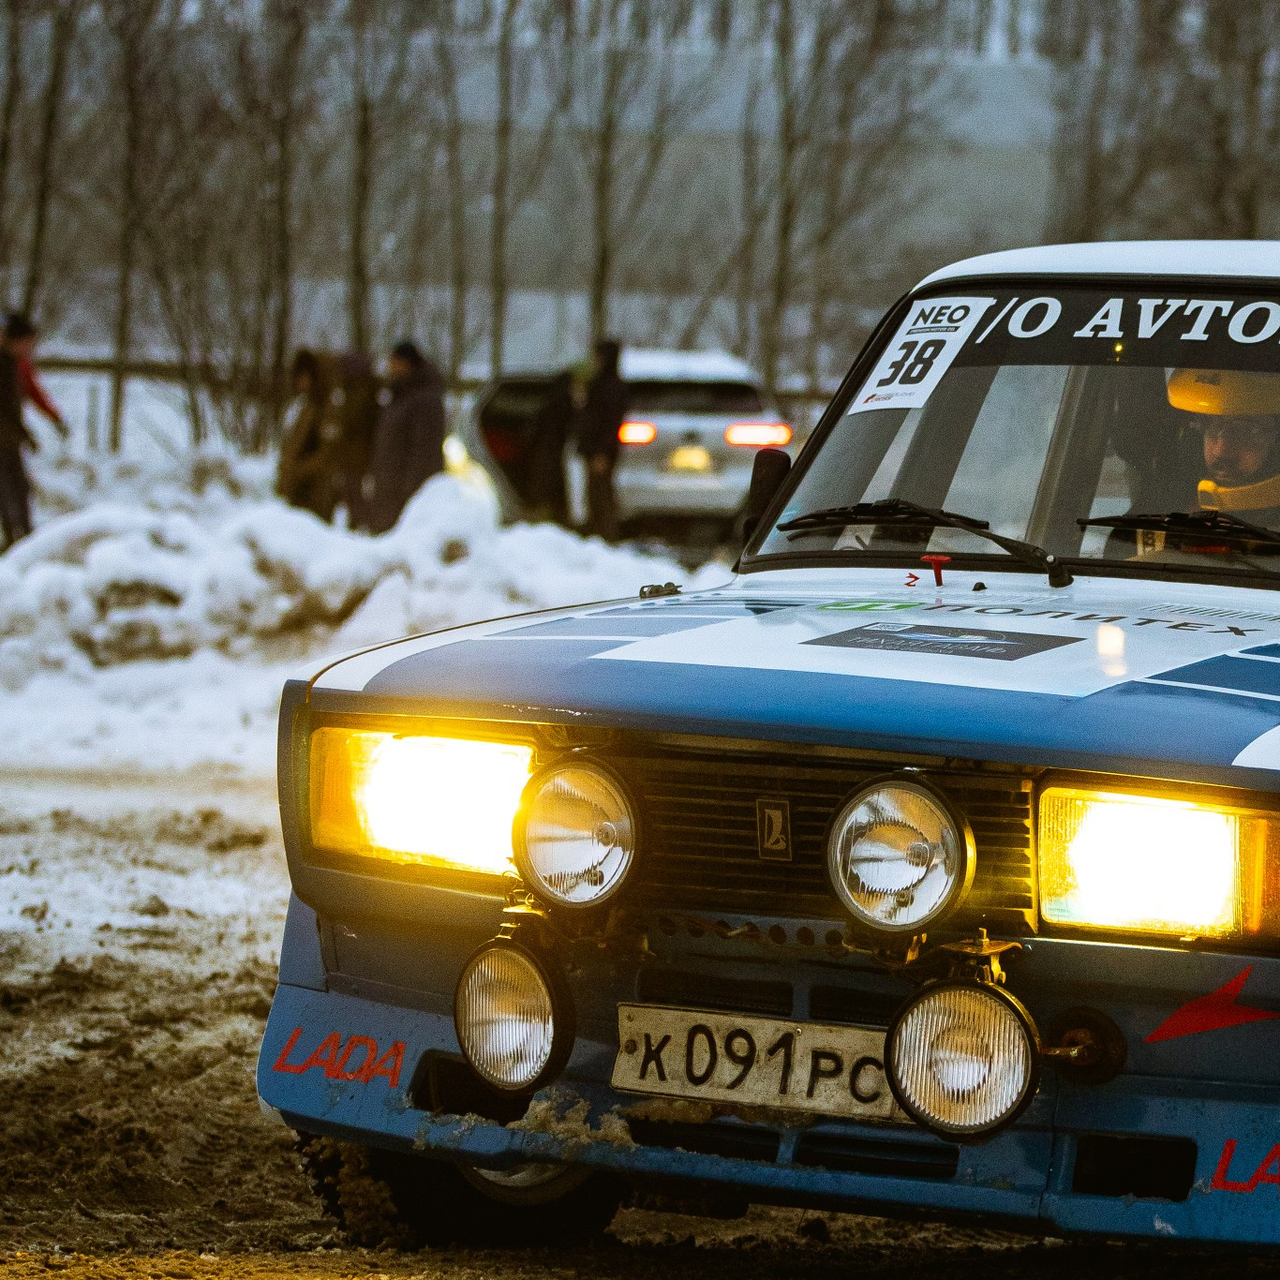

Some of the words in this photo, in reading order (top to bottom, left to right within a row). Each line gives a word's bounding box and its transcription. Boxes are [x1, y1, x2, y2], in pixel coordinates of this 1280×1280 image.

[911, 305, 971, 326] NEO
[974, 297, 1062, 344] /O
[876, 339, 947, 388] 38
[923, 604, 1264, 637] ПОЛИТЕХ
[271, 1025, 407, 1089] LADA
